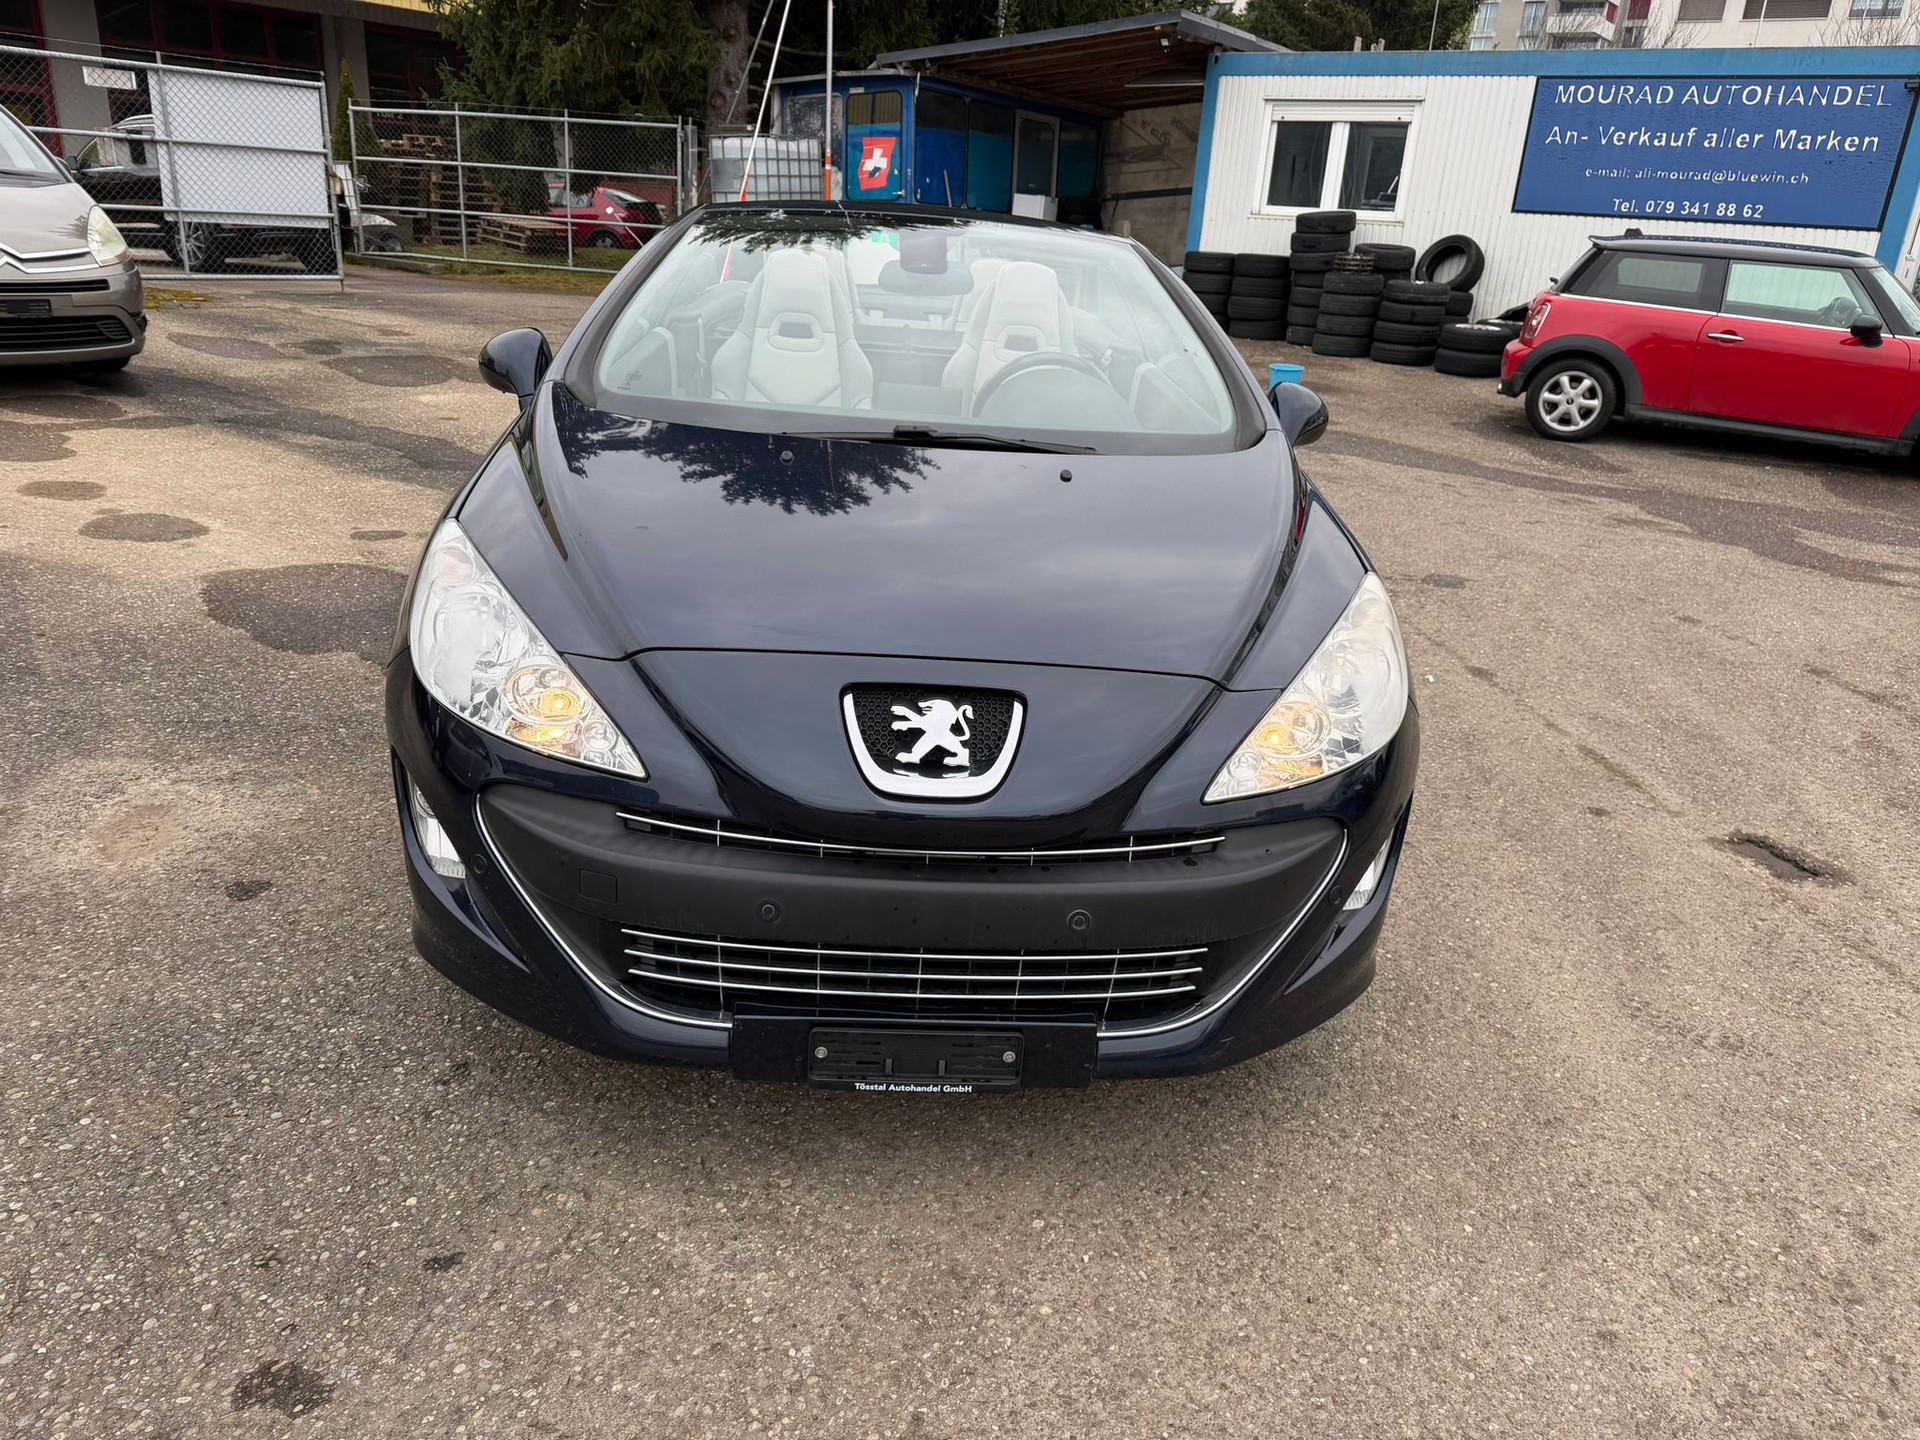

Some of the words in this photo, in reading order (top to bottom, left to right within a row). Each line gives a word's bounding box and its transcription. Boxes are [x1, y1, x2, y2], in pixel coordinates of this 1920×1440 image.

[1555, 84, 1674, 105] MOURAD
[1681, 85, 1892, 107] AUTOHANDEL
[1545, 125, 1589, 146] An-
[1599, 126, 1698, 148] Verkauf
[1703, 127, 1765, 150] aller
[1772, 128, 1880, 152] Marken
[1585, 166, 1631, 179] e-mail:
[1635, 167, 1809, 185] ali-mourad@bluewin.ch
[1613, 198, 1639, 213] Tel.
[1645, 200, 1675, 214] 079
[1680, 201, 1709, 216] 341
[1716, 202, 1737, 217] 88
[1742, 203, 1764, 218] 62
[888, 1083, 941, 1093] Autohandel
[943, 1085, 973, 1093] GmbH
